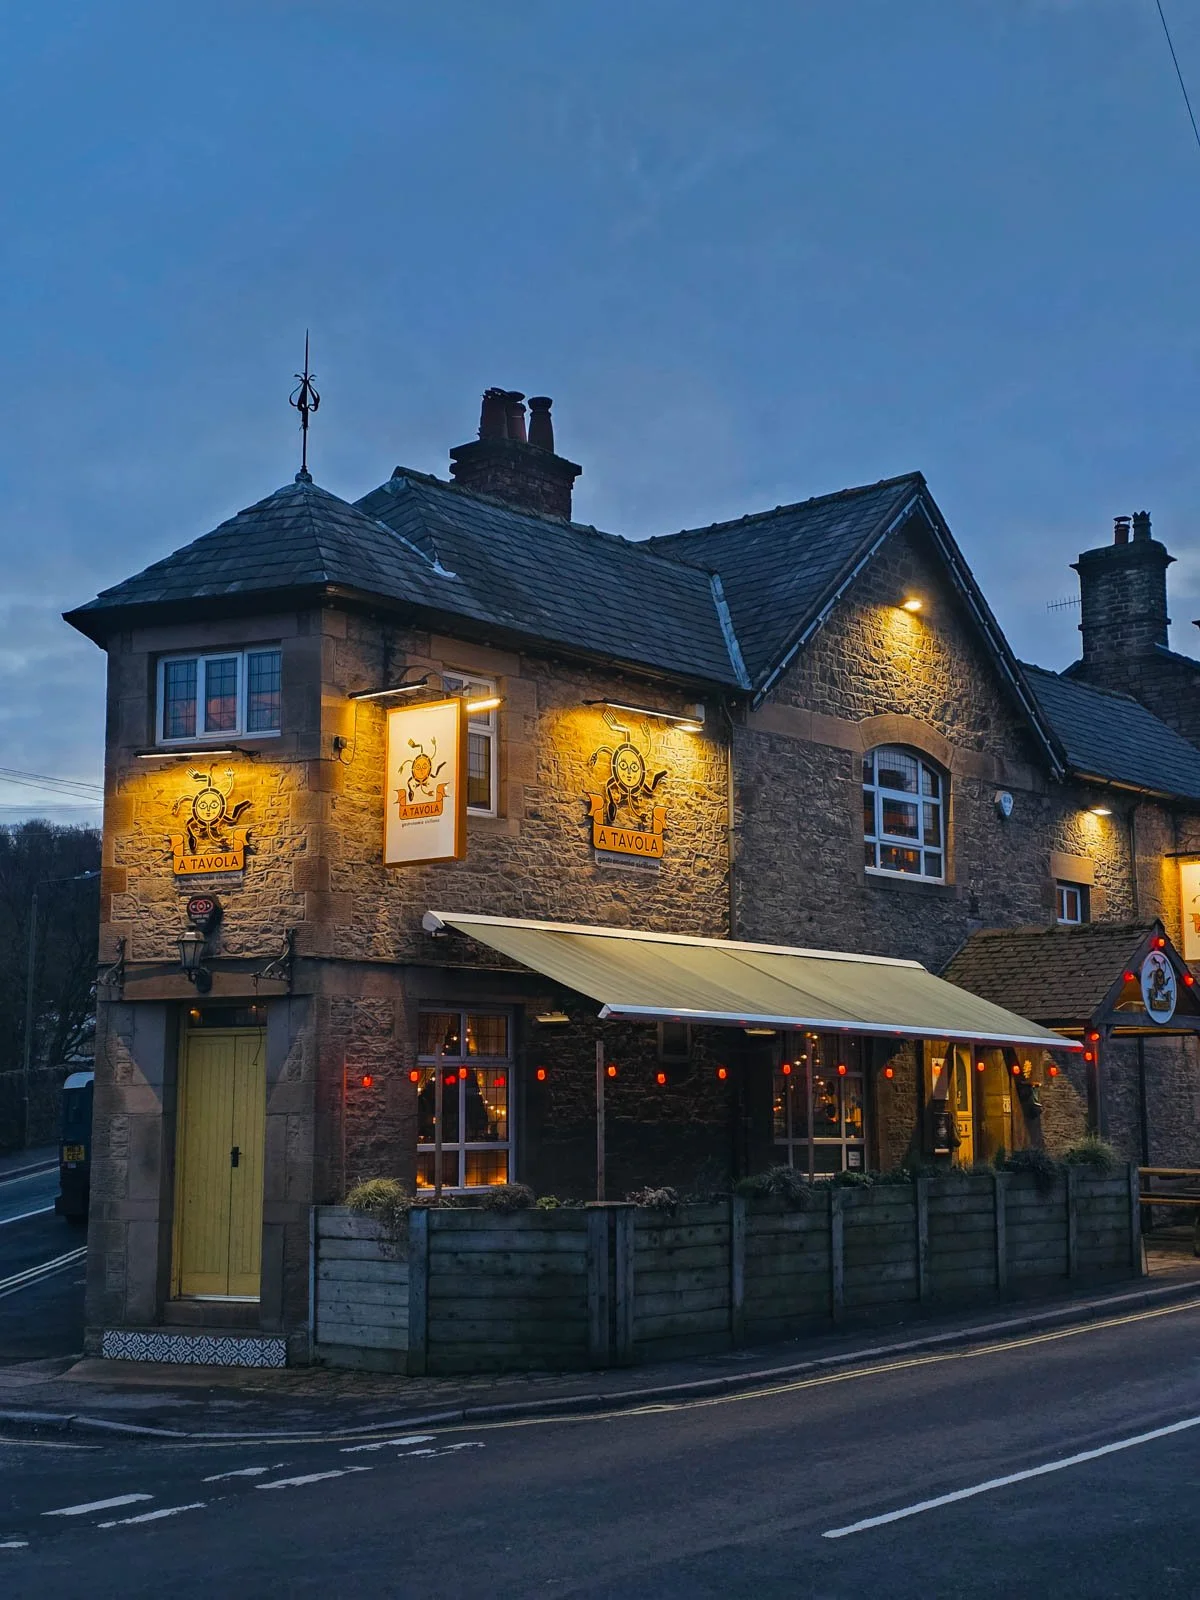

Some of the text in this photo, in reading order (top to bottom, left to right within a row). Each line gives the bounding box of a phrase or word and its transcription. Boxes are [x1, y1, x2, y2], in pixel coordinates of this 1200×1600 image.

[402, 804, 440, 817] A TAVOLA
[598, 830, 659, 853] A TAVOLA
[178, 855, 239, 871] A TAVOLA
